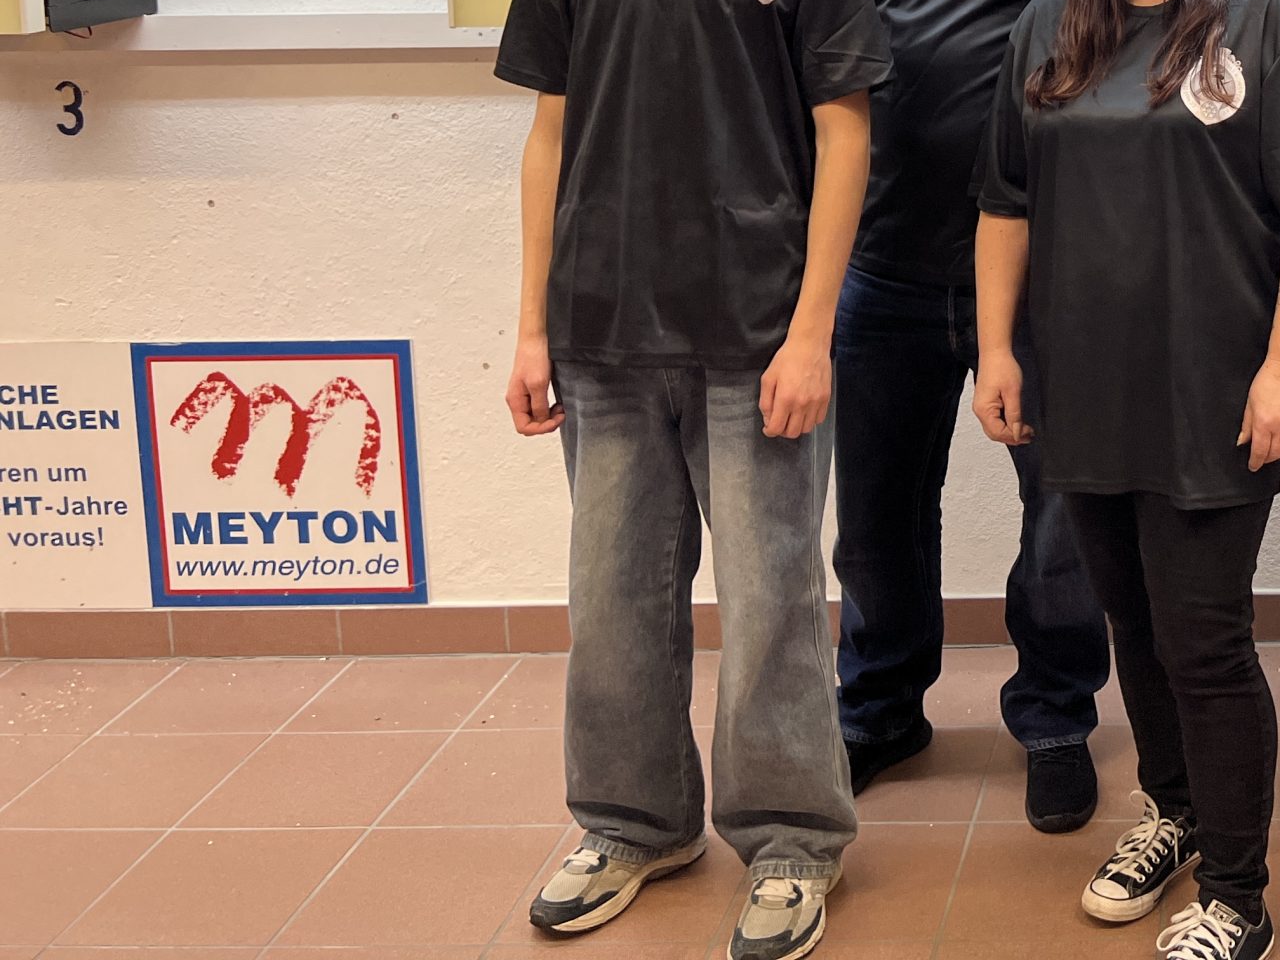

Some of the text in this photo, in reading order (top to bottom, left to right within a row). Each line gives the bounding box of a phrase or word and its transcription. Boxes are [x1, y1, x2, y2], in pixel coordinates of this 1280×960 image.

[55, 80, 84, 136] 3
[0, 385, 59, 405] CHE
[0, 410, 120, 430] NLAGEN
[47, 467, 87, 482] um
[0, 496, 128, 516] HT-Jahre
[7, 527, 104, 547] voraus!
[171, 510, 399, 545] MEYTON
[176, 554, 400, 581] www.meyton.de
